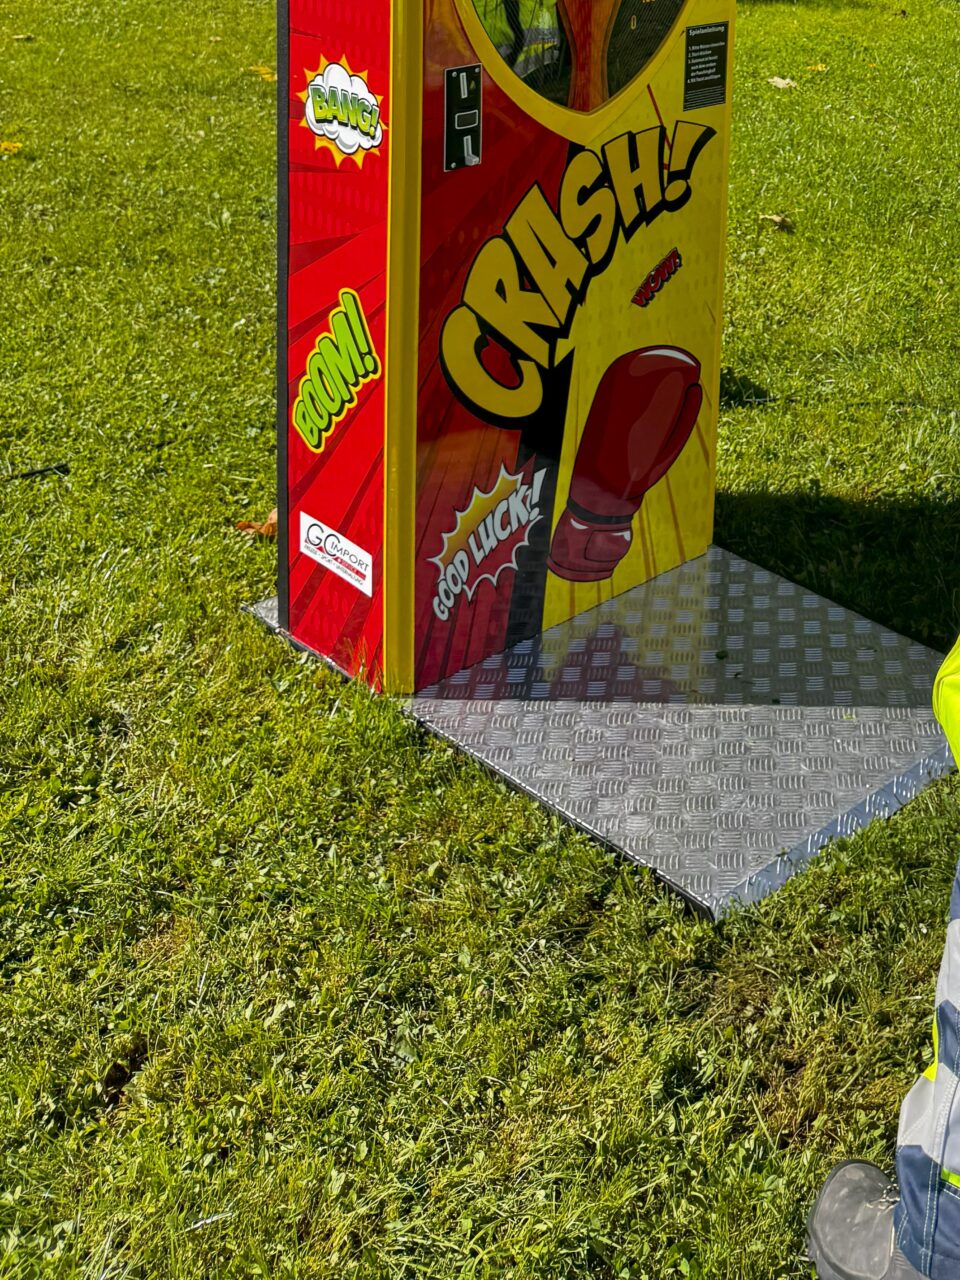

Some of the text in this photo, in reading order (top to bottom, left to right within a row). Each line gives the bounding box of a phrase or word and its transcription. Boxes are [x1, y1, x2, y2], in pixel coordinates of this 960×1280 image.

[630, 15, 637, 30] 0
[308, 84, 380, 139] BANG!
[440, 120, 716, 426] CRASH!
[631, 247, 682, 308] WOW!
[294, 291, 376, 449] BOOM!
[432, 467, 547, 621] GOOD LUCK!
